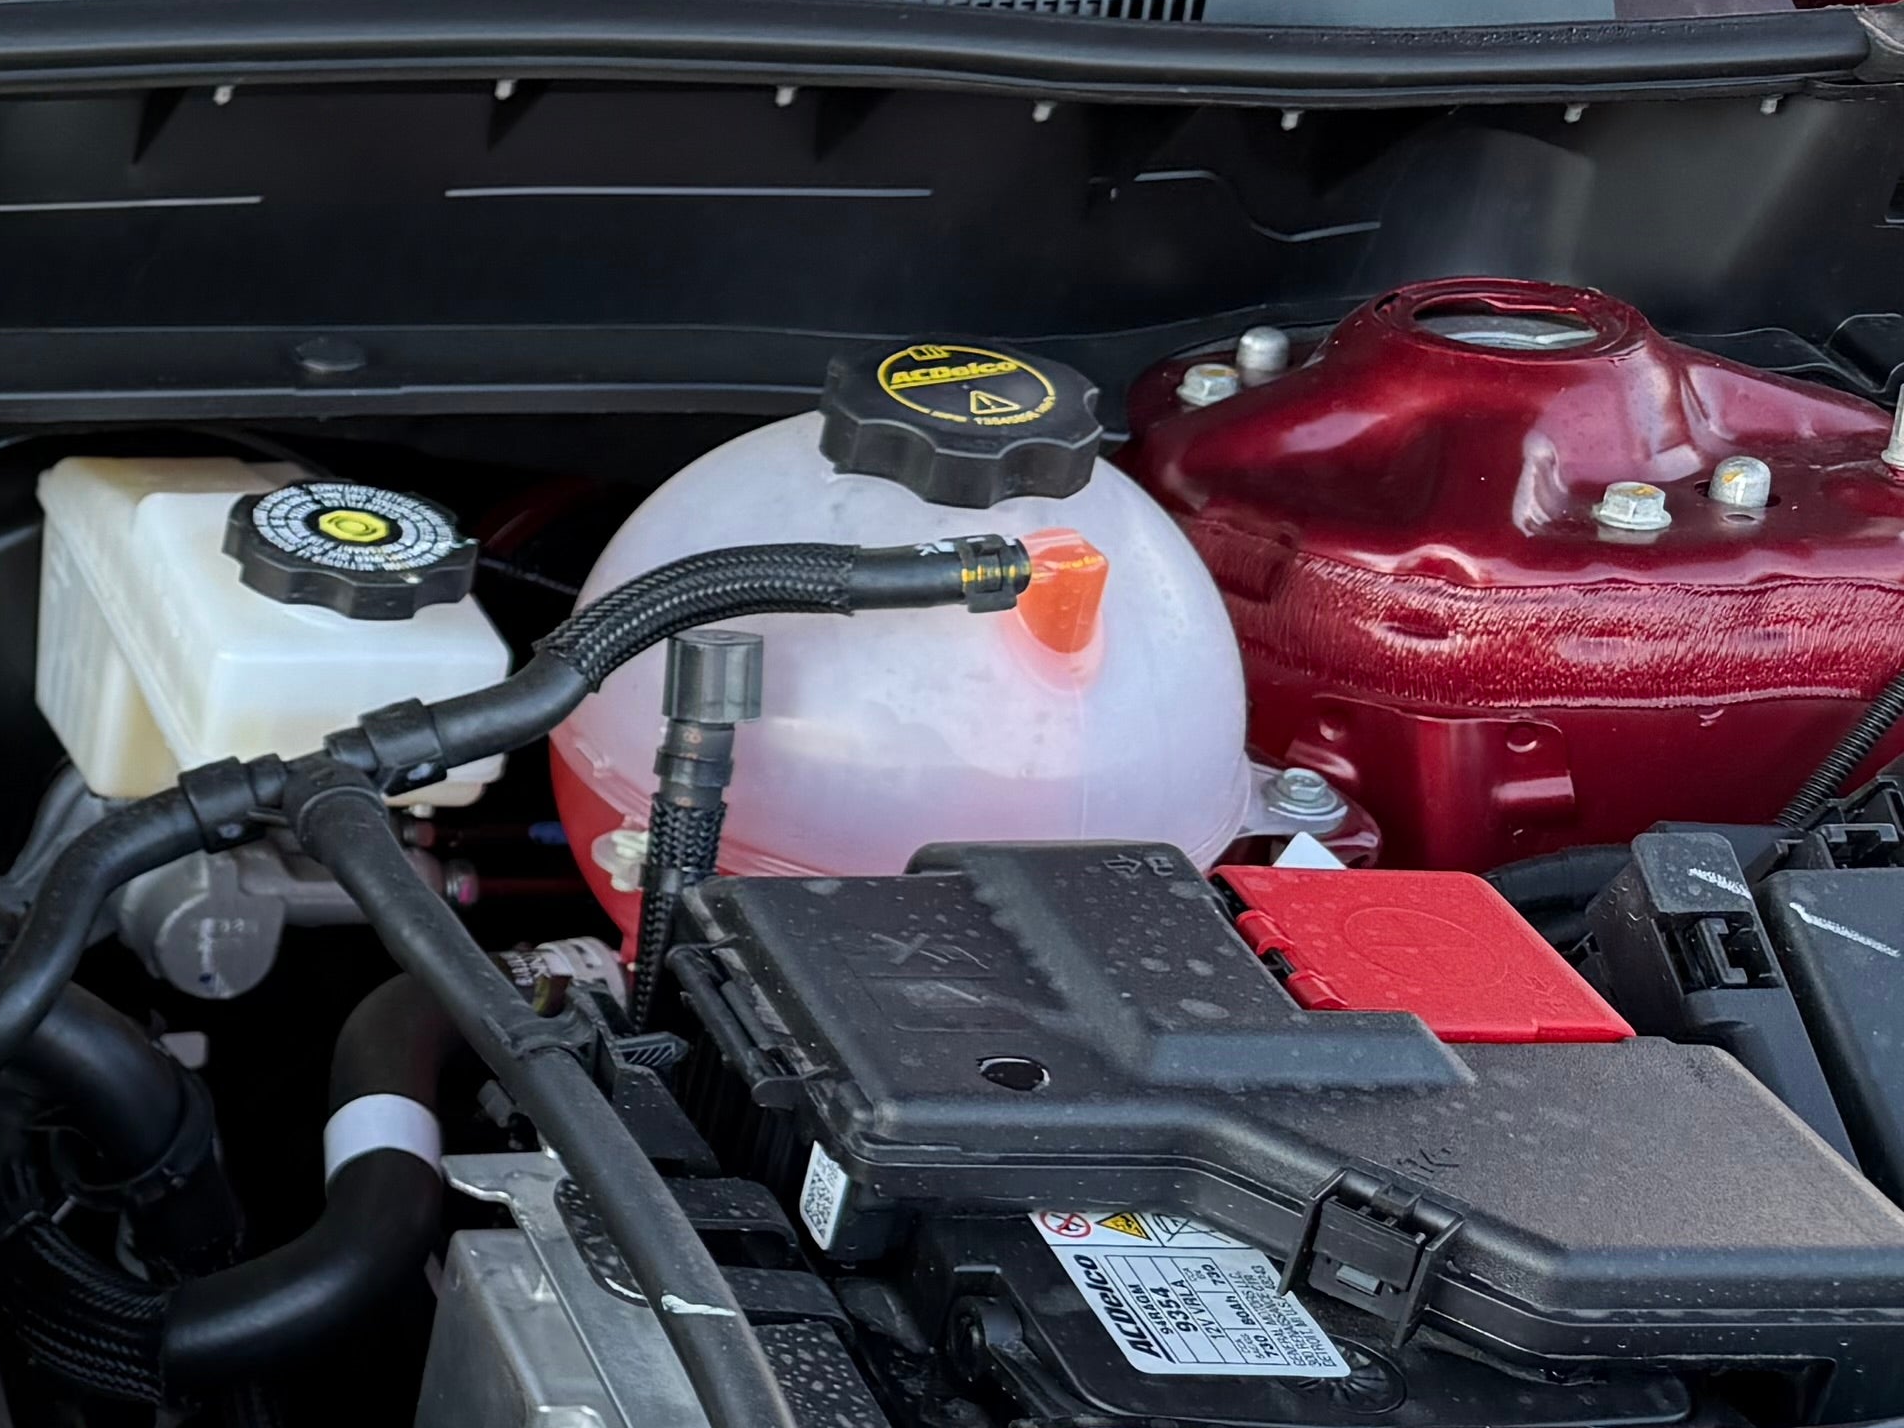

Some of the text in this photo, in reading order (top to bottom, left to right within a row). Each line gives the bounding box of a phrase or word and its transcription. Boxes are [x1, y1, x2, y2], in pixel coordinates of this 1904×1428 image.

[890, 362, 1017, 384] ACDelco
[1202, 1264, 1227, 1285] 730
[1073, 1254, 1162, 1358] ACDelco
[1129, 1284, 1174, 1334] 94RAGM
[1150, 1286, 1199, 1331] 9354
[1170, 1279, 1226, 1338] 12V VRLA
[1224, 1295, 1256, 1325] 80Ah
[1242, 1290, 1277, 1325] MOTORS
[1258, 1292, 1309, 1348] RENAISSANCE
[1254, 1334, 1280, 1356] 730
[1271, 1328, 1307, 1366] GENERAL
